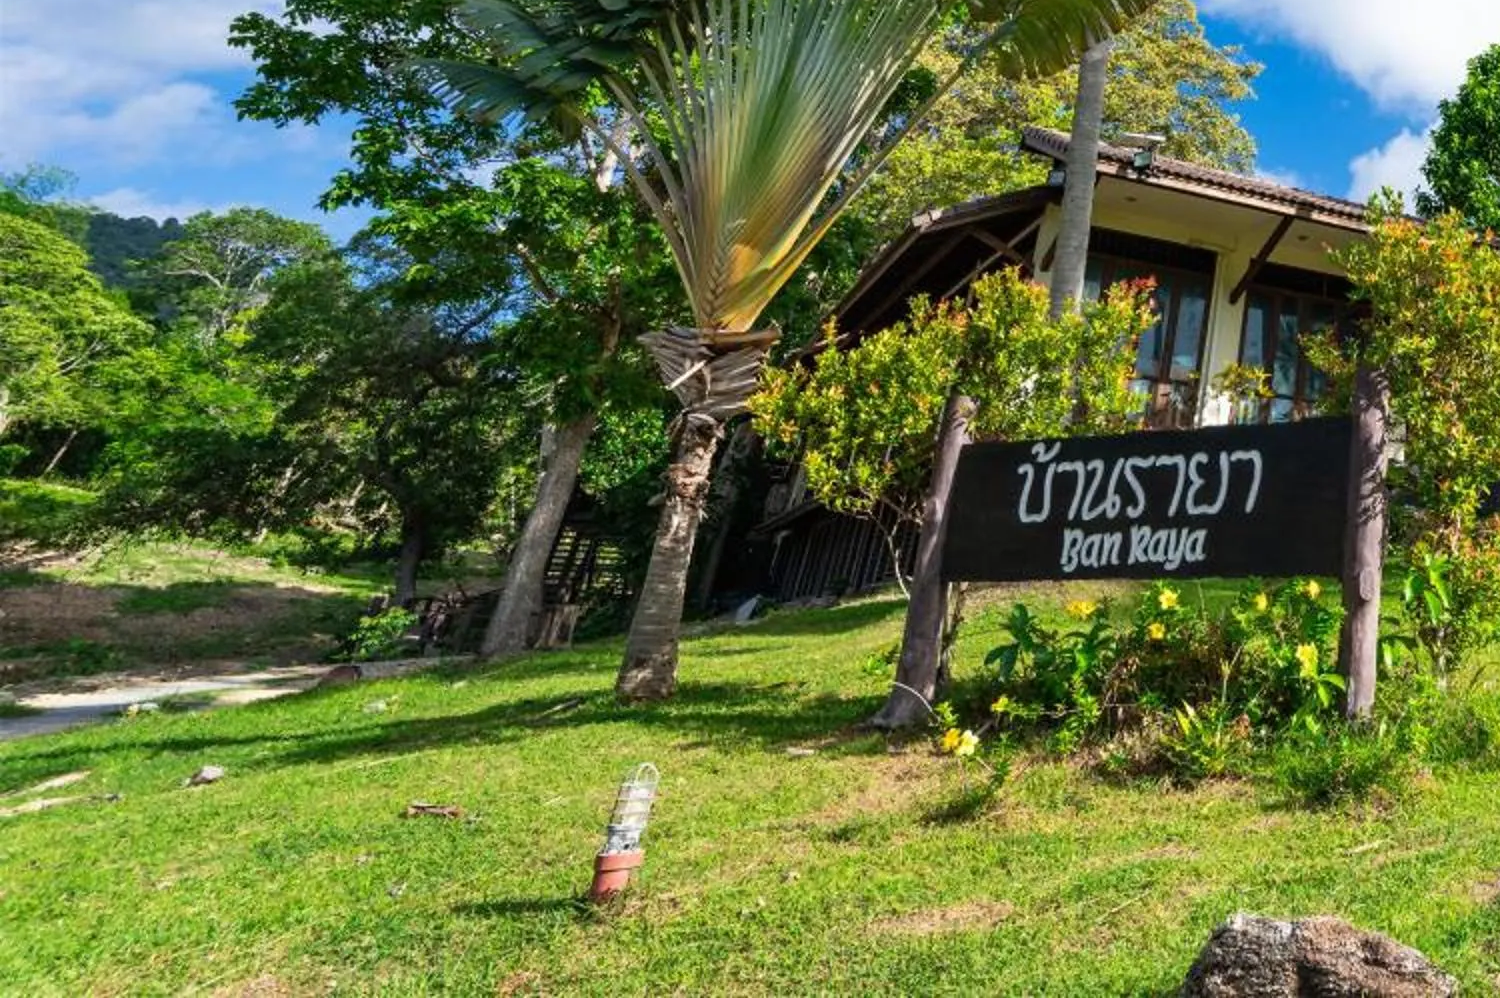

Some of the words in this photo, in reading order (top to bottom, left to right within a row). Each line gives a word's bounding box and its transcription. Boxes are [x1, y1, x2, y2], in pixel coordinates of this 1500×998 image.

[1017, 441, 1263, 523] บ้านรายา
[1060, 528, 1121, 572] Ban
[1127, 526, 1206, 570] Raya
